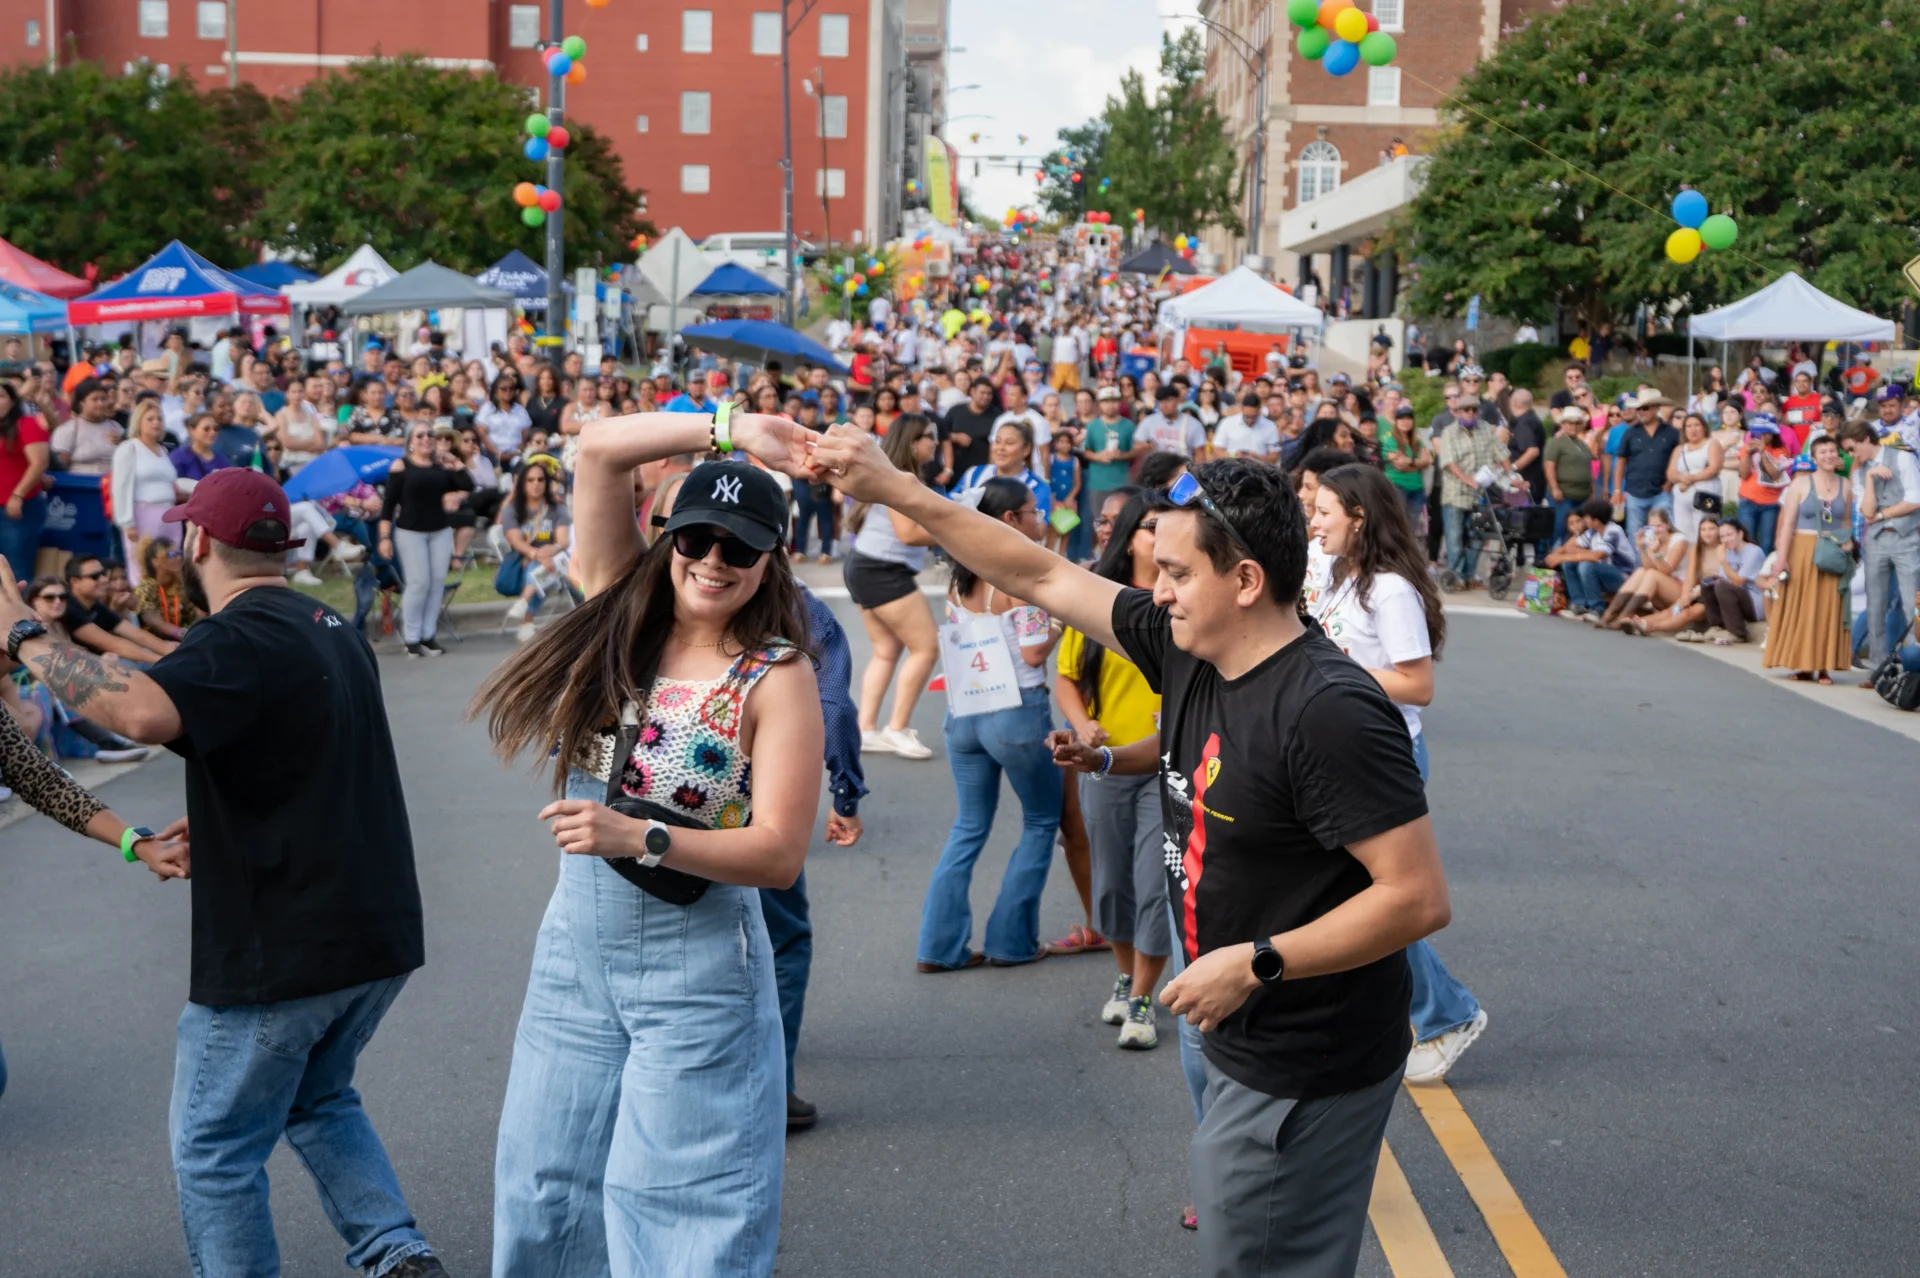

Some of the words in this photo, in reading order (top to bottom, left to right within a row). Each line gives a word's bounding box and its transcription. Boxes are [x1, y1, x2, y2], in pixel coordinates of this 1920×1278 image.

[500, 271, 538, 284] Fidelity
[711, 474, 743, 504] NY
[970, 651, 989, 673] 4
